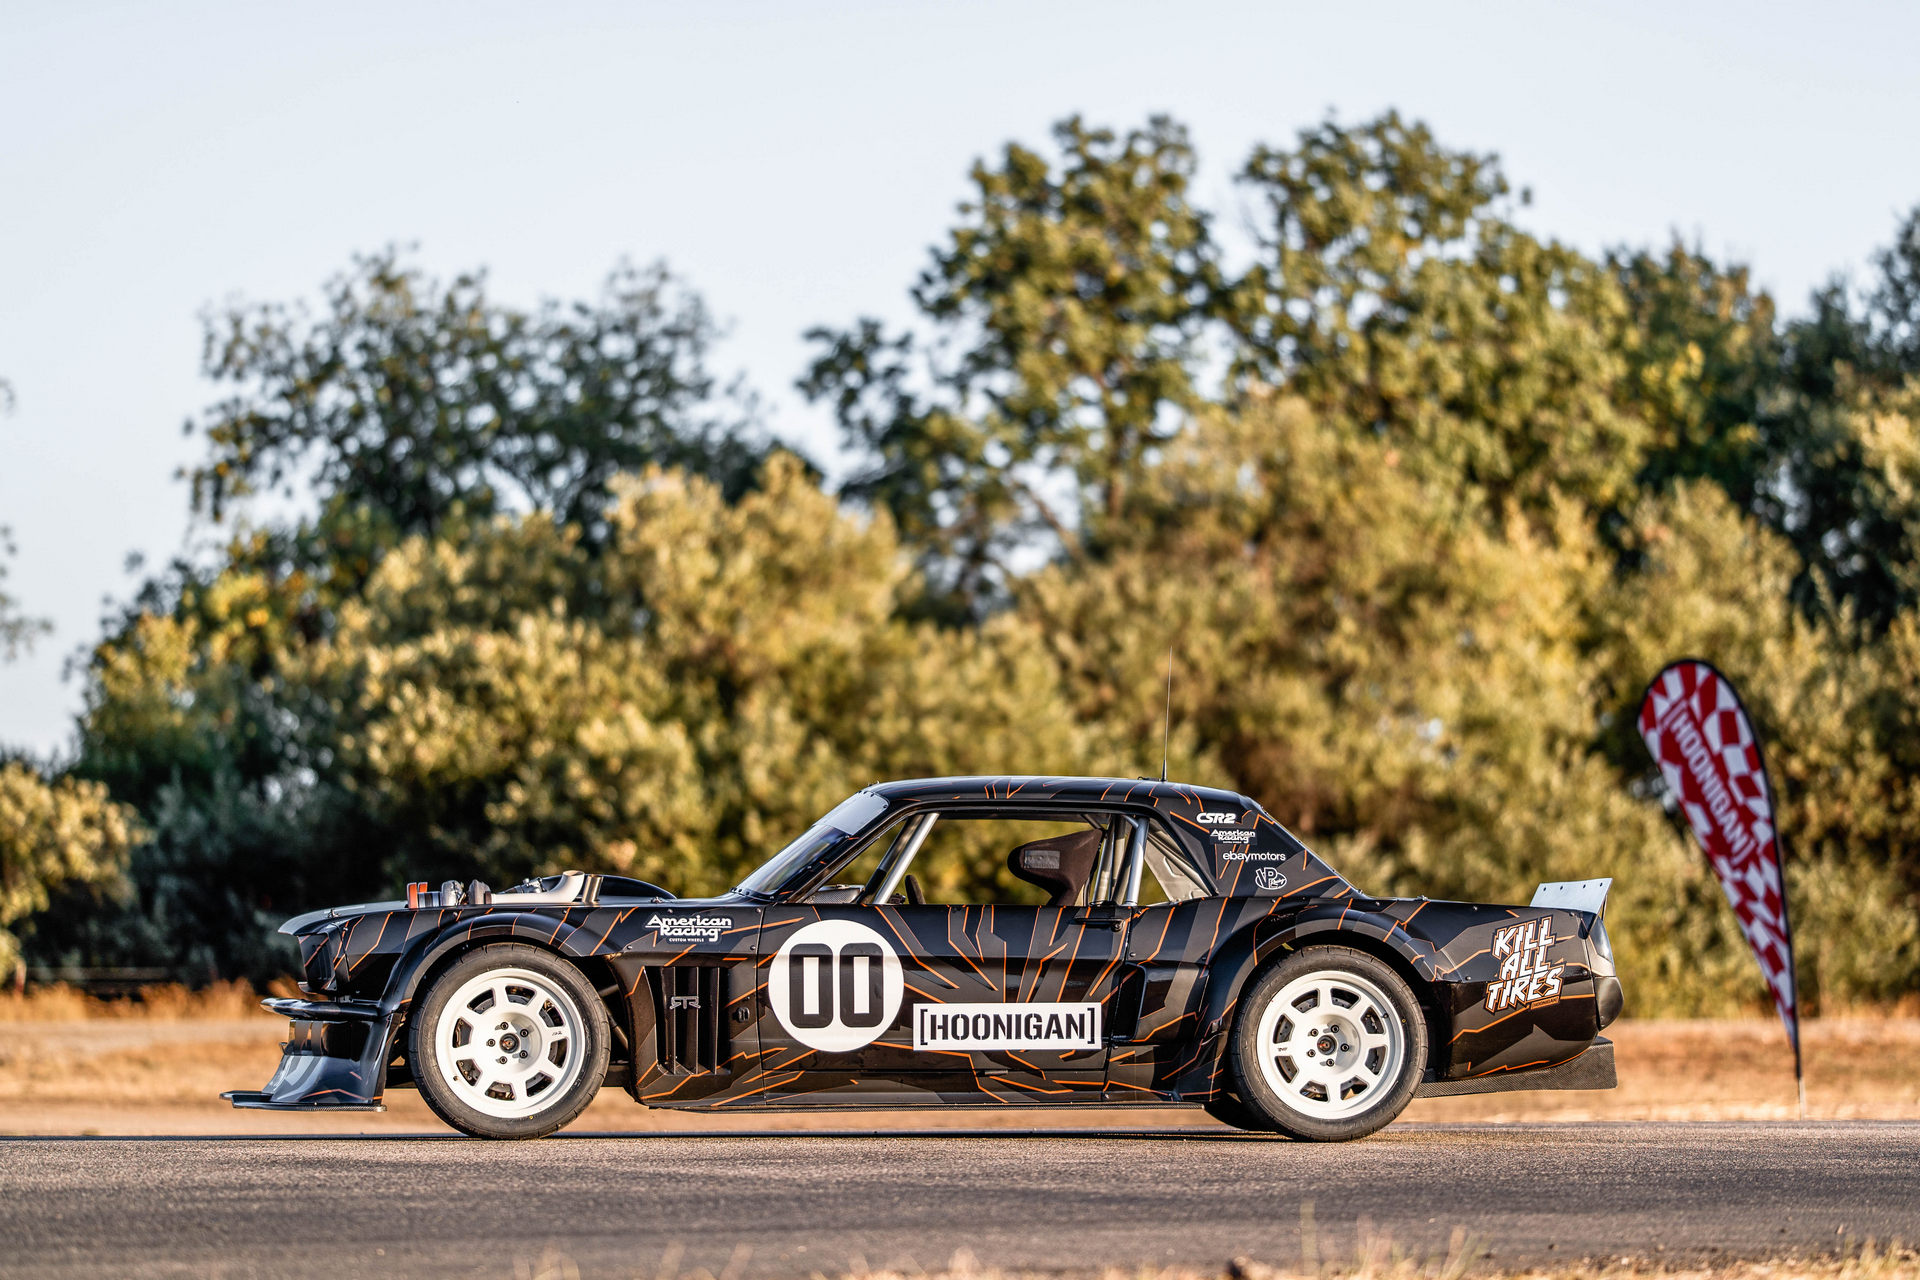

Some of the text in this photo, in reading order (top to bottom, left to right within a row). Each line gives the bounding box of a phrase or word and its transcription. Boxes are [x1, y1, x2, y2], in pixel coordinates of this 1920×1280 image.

[1196, 813, 1236, 823] CSR2
[1210, 829, 1256, 837] American
[1218, 834, 1249, 843] Racing
[1223, 851, 1286, 862] ebaymotors
[645, 914, 732, 928] American
[660, 925, 721, 942] Racing
[1494, 919, 1553, 957] KILL
[1501, 946, 1548, 980] ALL
[789, 943, 884, 1028] 00
[1487, 968, 1562, 1010] TIRES
[920, 1008, 1095, 1044] [HOONIGAN]
